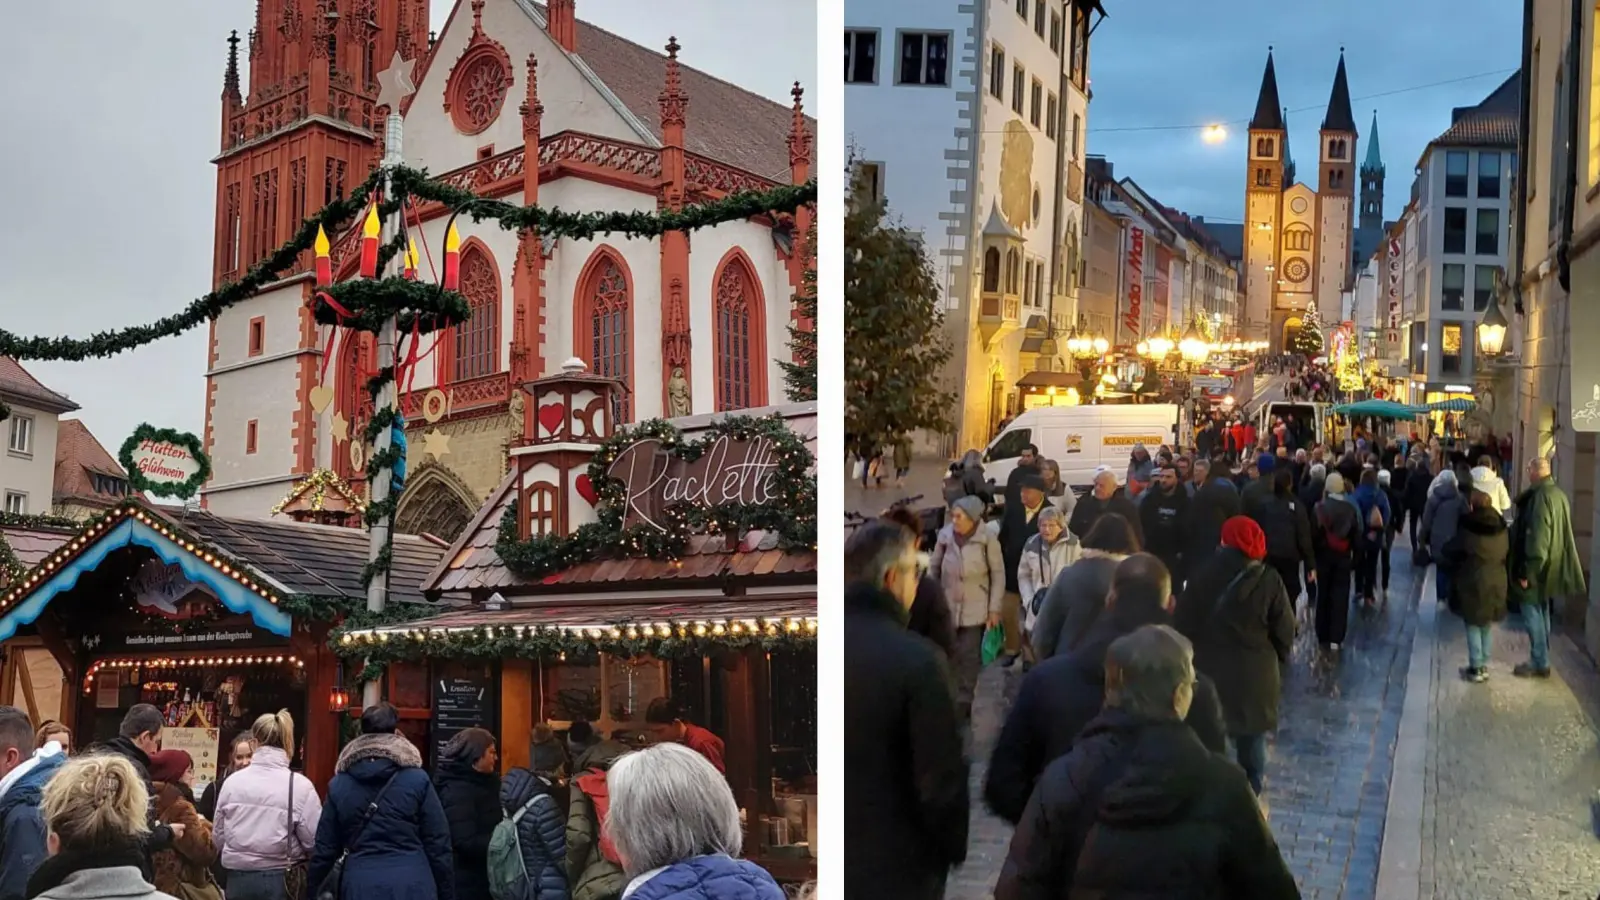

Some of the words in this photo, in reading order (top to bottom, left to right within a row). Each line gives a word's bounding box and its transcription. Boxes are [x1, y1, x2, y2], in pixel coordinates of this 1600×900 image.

[1128, 226, 1143, 274] Markt
[1125, 284, 1140, 336] Media
[1389, 238, 1401, 343] Severin
[139, 457, 185, 479] Glühwein
[607, 435, 780, 533] Raclette
